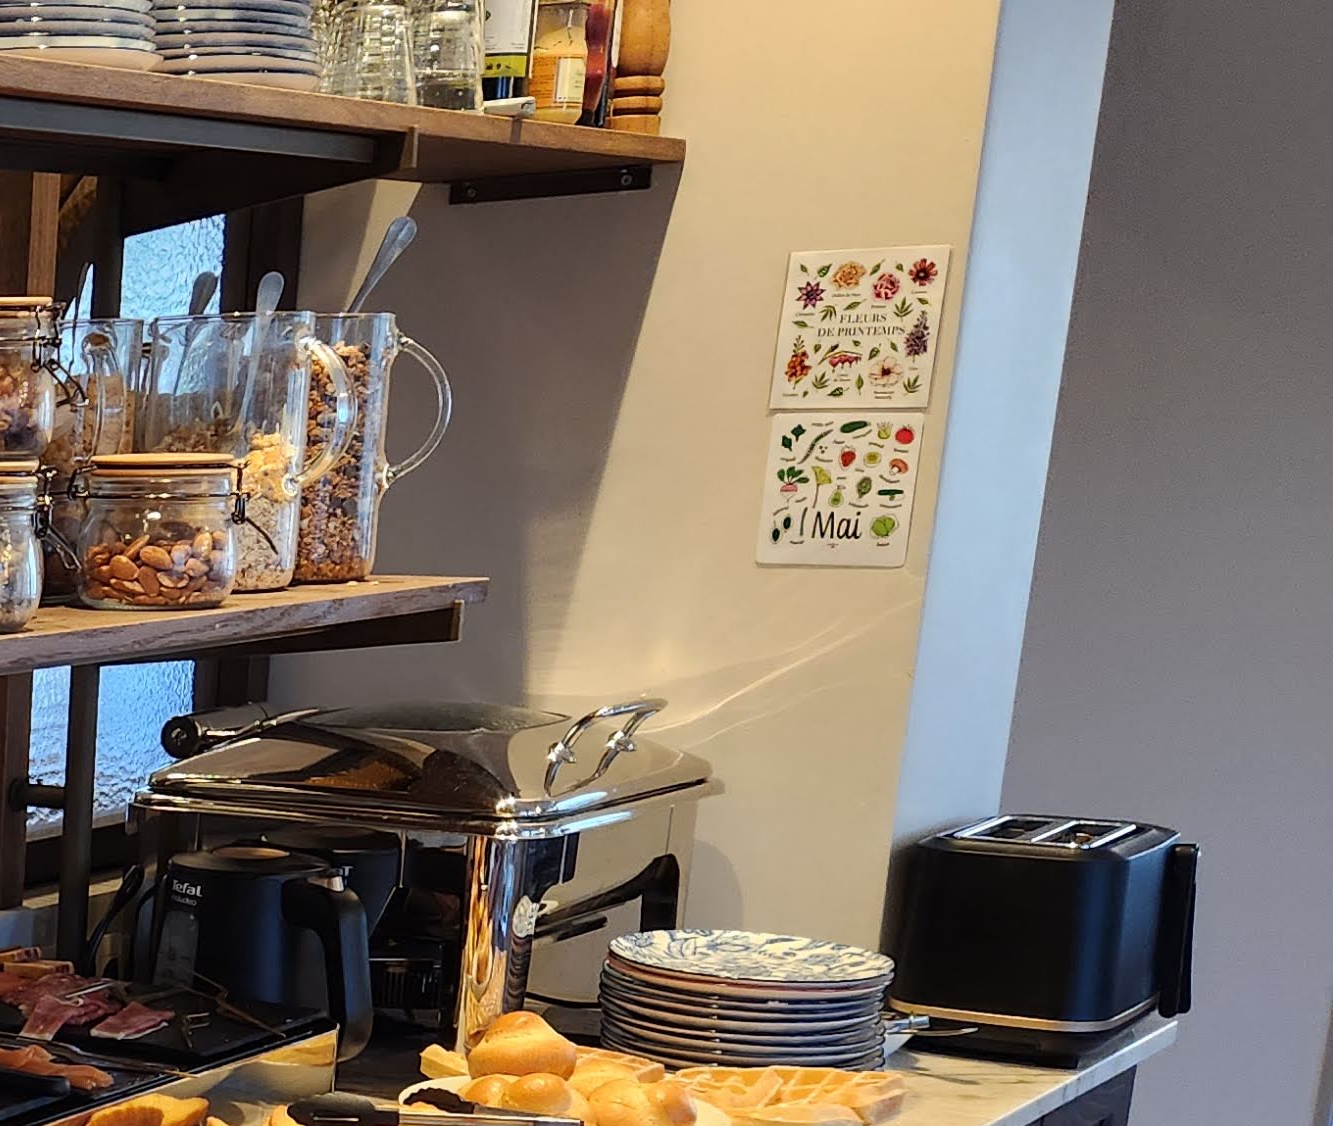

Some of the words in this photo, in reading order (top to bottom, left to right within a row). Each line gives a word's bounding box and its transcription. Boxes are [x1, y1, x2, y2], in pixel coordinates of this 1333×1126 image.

[839, 313, 887, 323] FLEURS
[817, 328, 834, 337] DE
[837, 326, 906, 336] PRINTEMPS
[811, 511, 862, 539] Mai
[173, 879, 203, 897] Tefal
